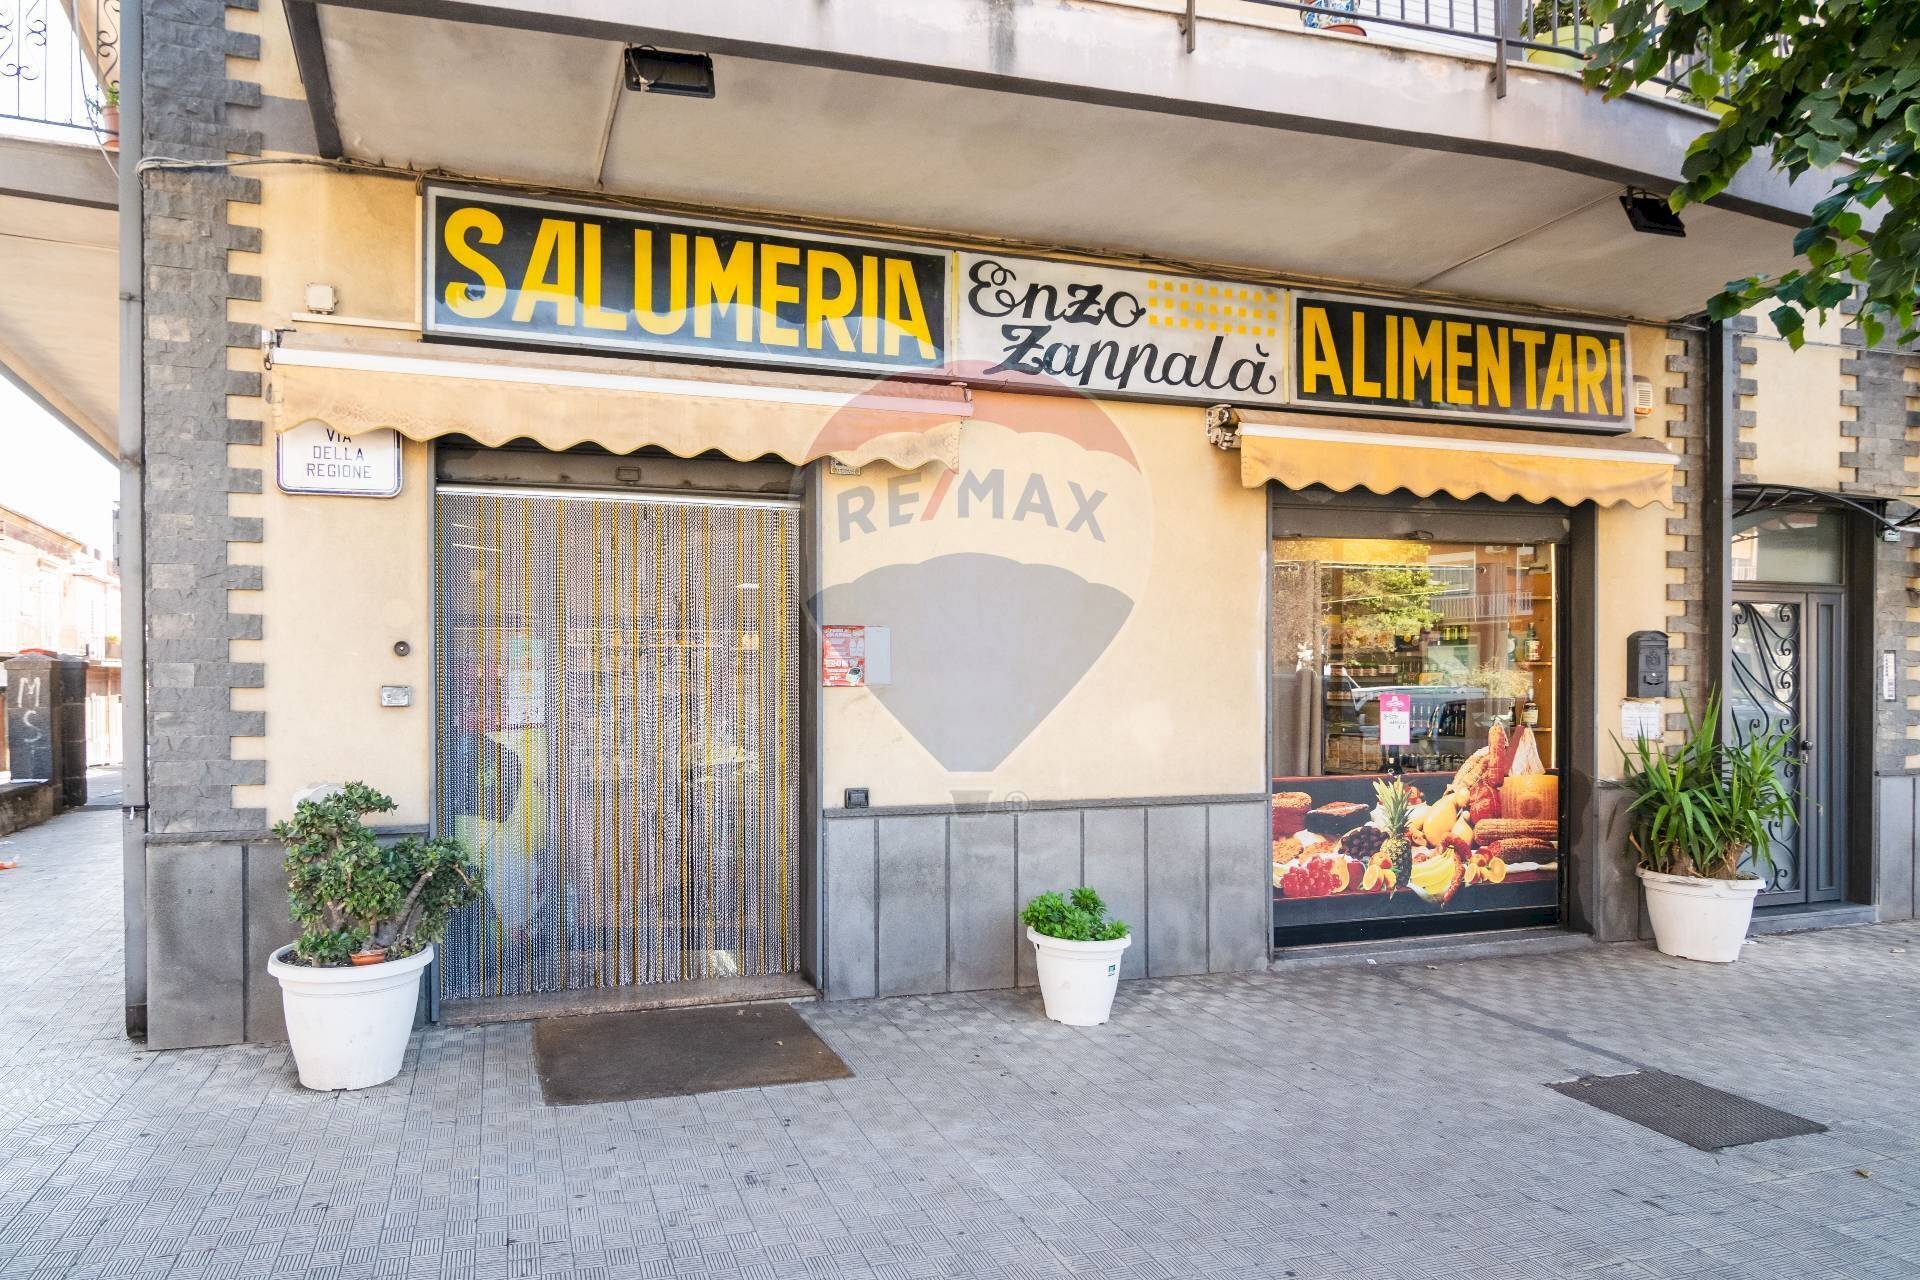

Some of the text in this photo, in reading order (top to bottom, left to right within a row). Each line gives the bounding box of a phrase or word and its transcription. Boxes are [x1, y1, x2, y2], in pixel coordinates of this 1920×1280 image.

[443, 206, 937, 360] SALUMERIA
[967, 259, 1146, 328] Enzo
[983, 324, 1277, 395] Zappalà
[1301, 306, 1624, 417] ALIMENTARI
[306, 463, 373, 479] REGIONE
[313, 445, 365, 462] DELLA
